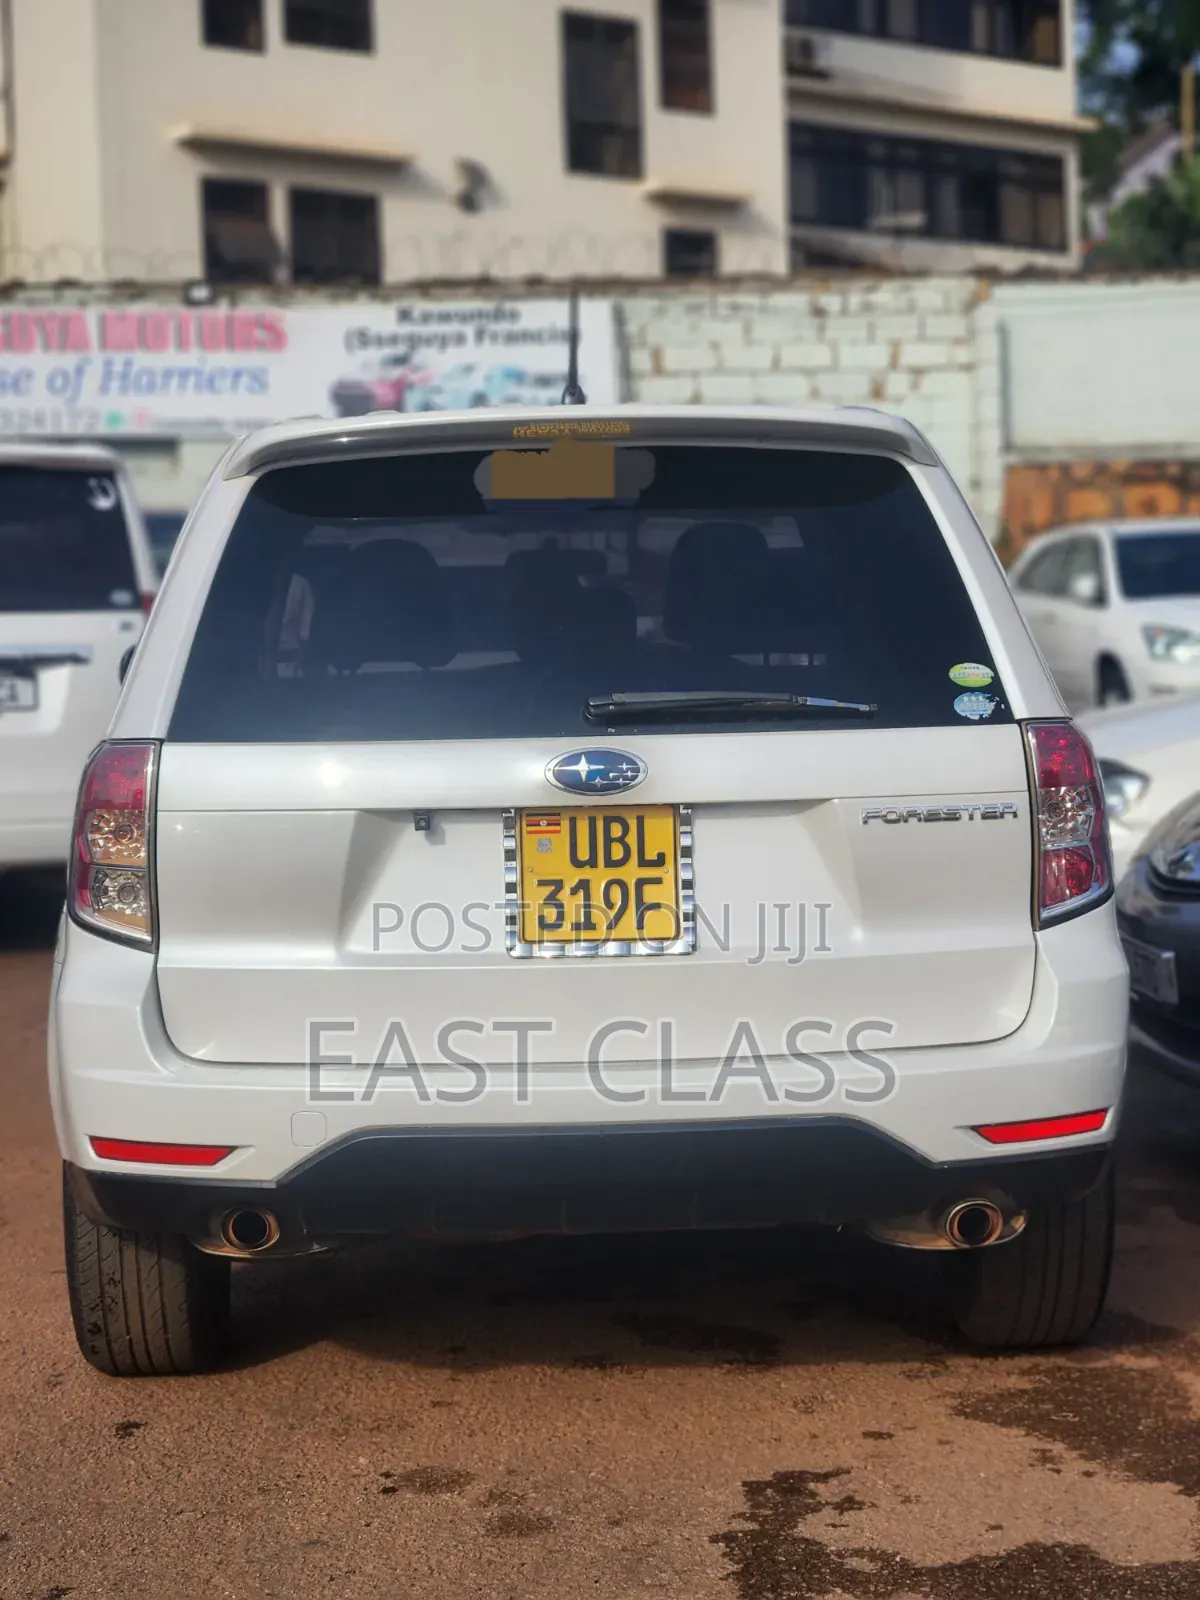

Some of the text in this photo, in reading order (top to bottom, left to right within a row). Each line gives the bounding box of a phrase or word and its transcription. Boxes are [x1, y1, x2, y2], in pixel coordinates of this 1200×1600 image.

[98, 310, 288, 353] MOTORS
[46, 356, 94, 405] of
[99, 355, 270, 397] Harriers
[861, 802, 1018, 825] FORESTER
[569, 815, 666, 869] UBL
[536, 877, 663, 931] 319F
